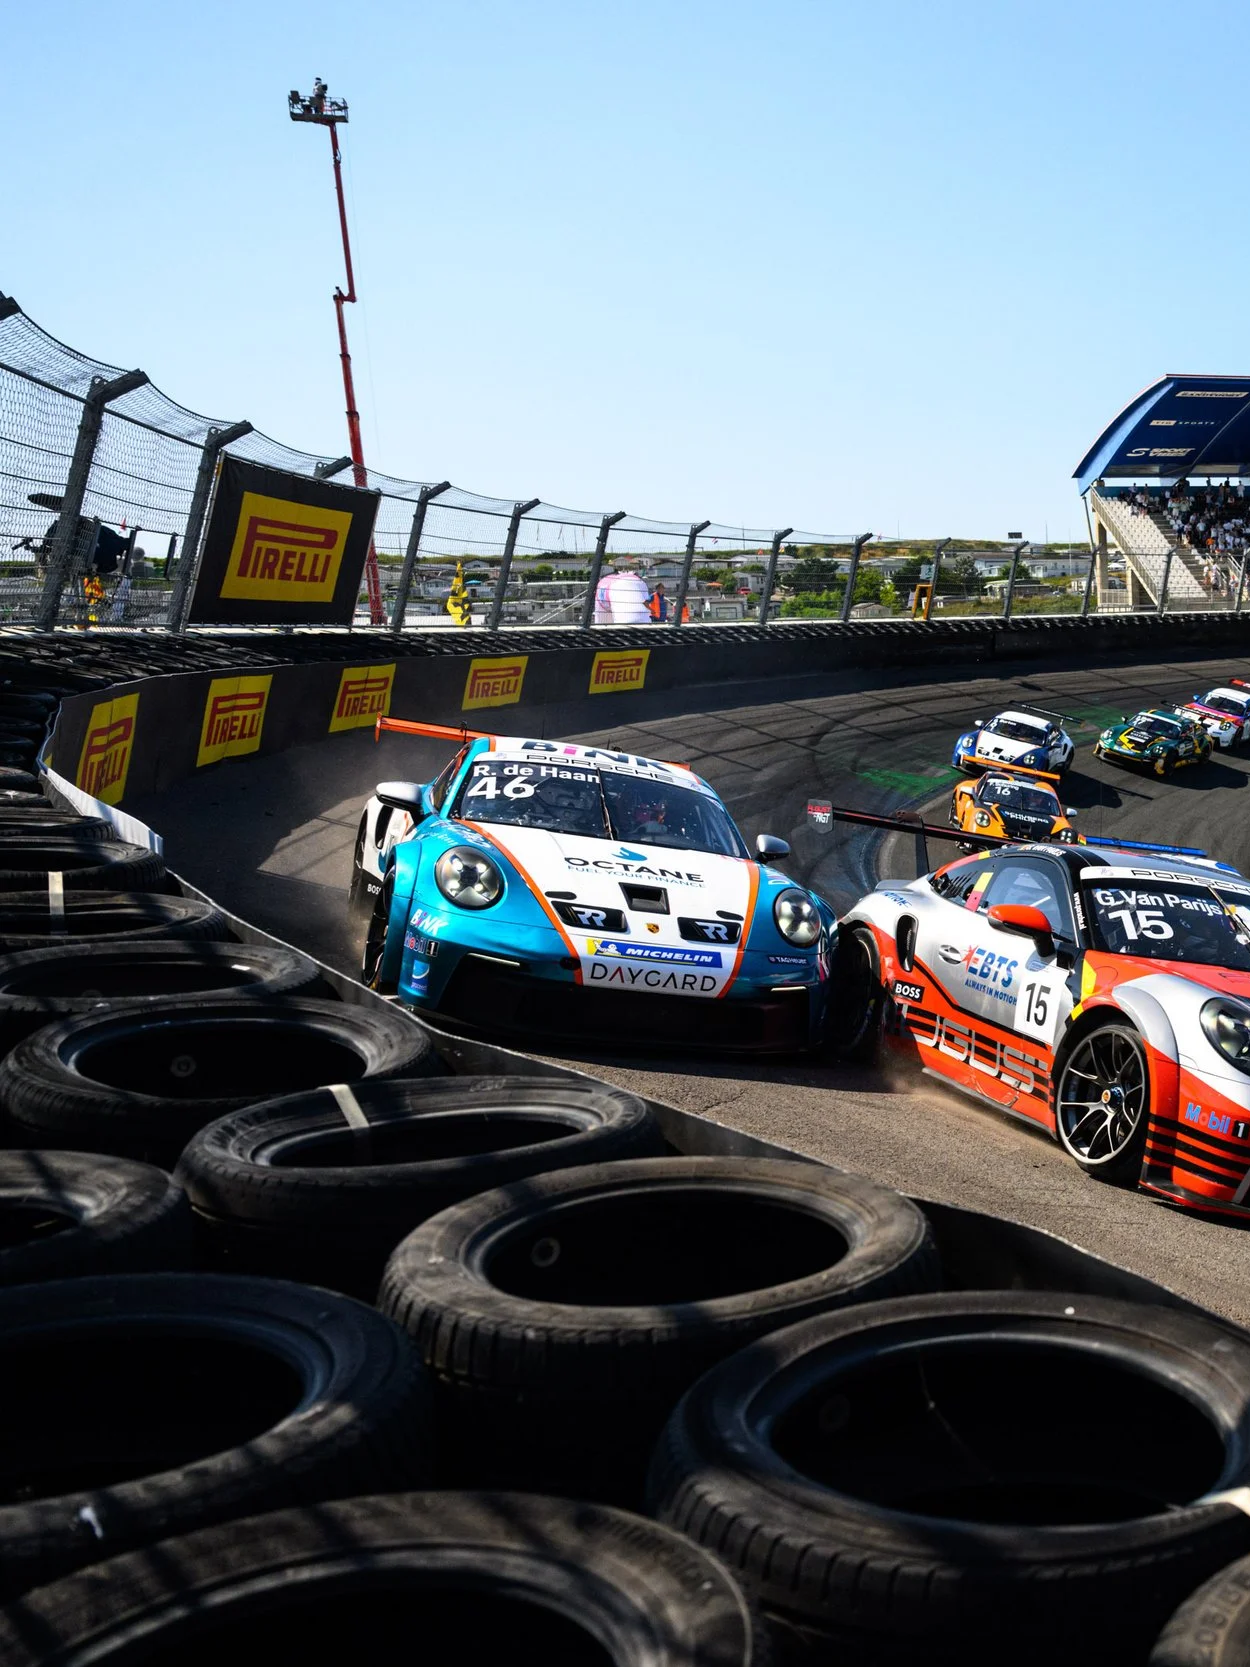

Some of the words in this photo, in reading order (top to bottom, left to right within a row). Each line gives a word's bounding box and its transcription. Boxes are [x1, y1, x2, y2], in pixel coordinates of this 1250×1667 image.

[238, 516, 338, 584] PIRELLI
[470, 666, 522, 699] PIRELLI
[595, 657, 643, 684] PIRELLI
[336, 676, 390, 718] PIRELLI
[205, 692, 265, 747] PIRELLI
[80, 717, 133, 798] PIRELLI
[526, 754, 673, 782] PORSCHE
[473, 765, 497, 777] R.
[503, 764, 534, 777] de
[540, 766, 600, 784] Haan
[467, 777, 536, 801] 46
[995, 786, 1011, 796] 16
[564, 857, 705, 883] OCTANE
[568, 865, 602, 876] FUEL
[604, 869, 643, 879] YOUR
[647, 874, 707, 888] FINANCE
[1122, 890, 1165, 907] Van
[1167, 894, 1223, 916] Parijs
[1109, 910, 1175, 941] 15
[404, 931, 427, 954] Mobil
[625, 947, 714, 964] MICHELIN
[967, 947, 1020, 988] EBTS
[895, 983, 921, 1000] BOSS
[965, 978, 987, 993] ALWAYS
[1025, 982, 1052, 1027] 15
[1185, 1102, 1231, 1135] Mobil
